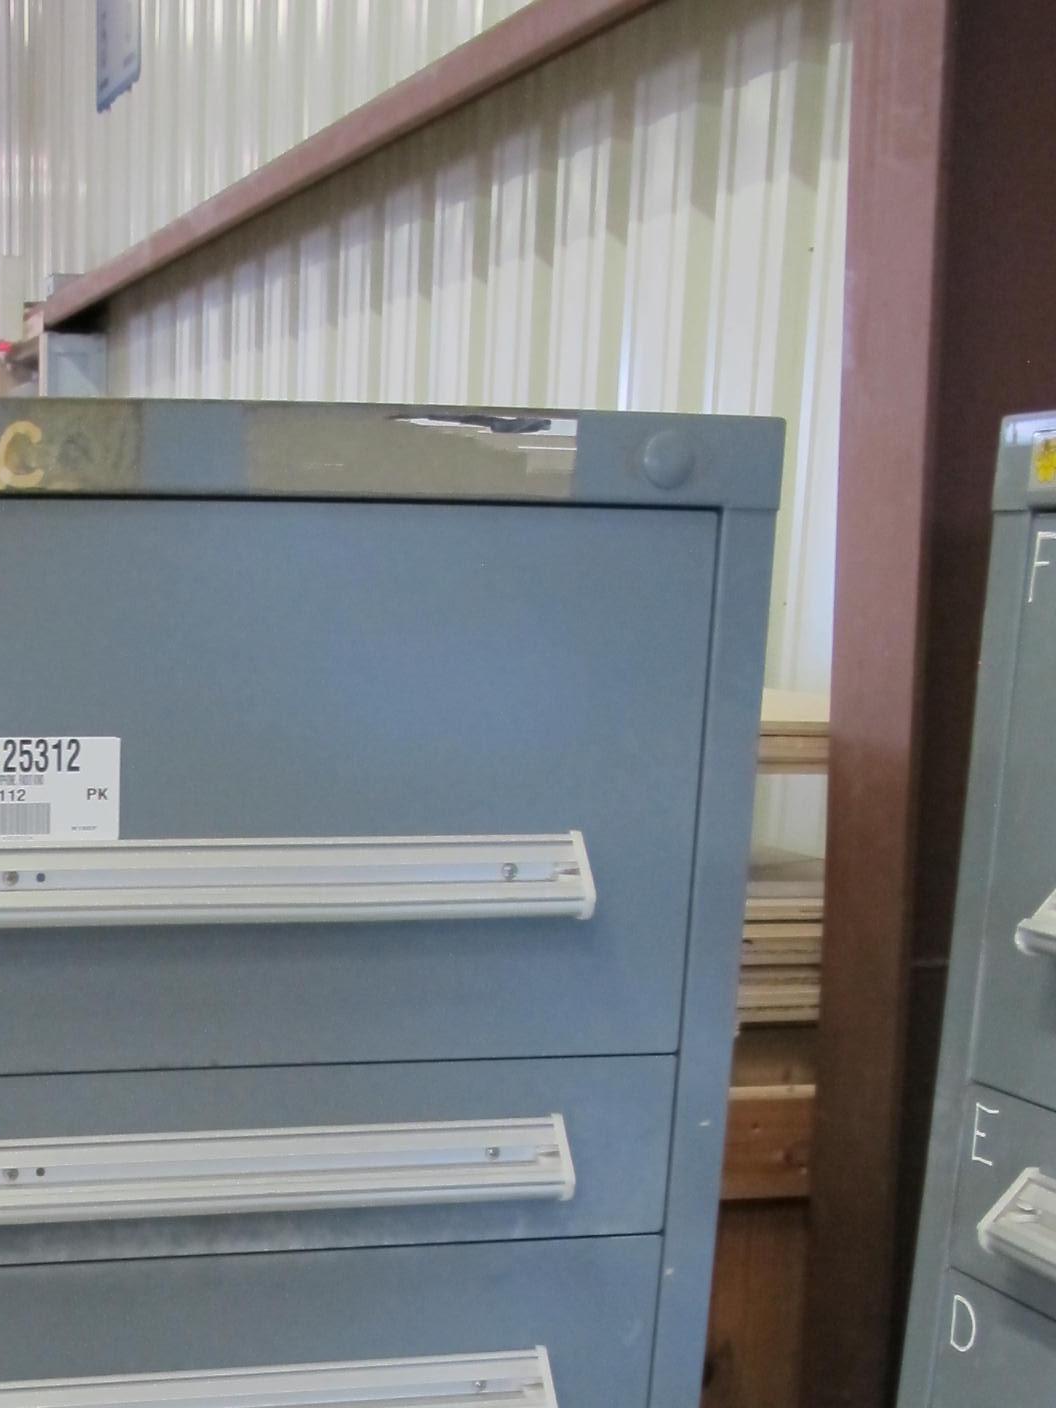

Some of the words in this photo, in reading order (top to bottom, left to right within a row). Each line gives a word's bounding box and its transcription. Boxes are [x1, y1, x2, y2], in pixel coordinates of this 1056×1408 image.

[86, 787, 108, 801] PK
[972, 1102, 1000, 1167] E
[949, 1294, 976, 1352] D
